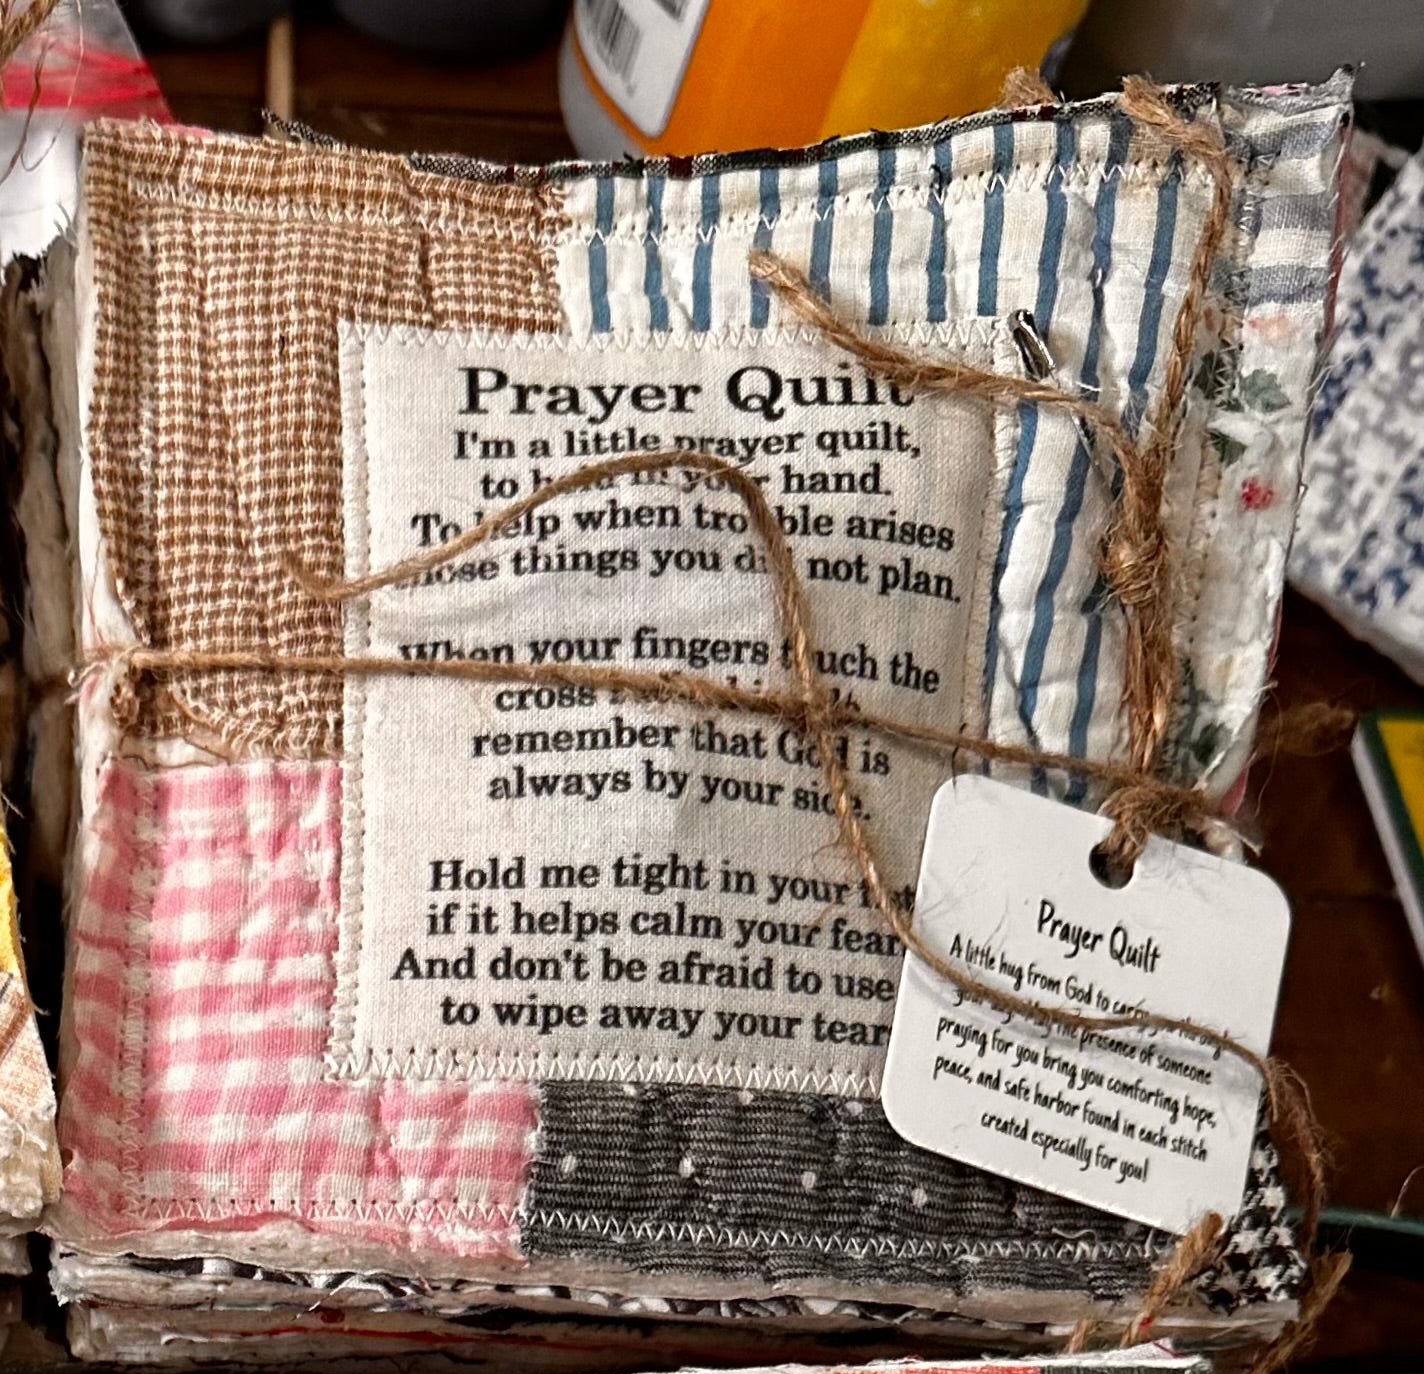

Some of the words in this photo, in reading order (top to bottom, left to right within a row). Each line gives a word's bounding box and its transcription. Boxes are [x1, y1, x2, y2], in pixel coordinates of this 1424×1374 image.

[458, 366, 704, 425] Prayer
[453, 429, 516, 460] I'm
[528, 438, 552, 459] a
[563, 426, 661, 457] little
[815, 420, 921, 463] quilt,
[1037, 898, 1105, 959] Prayer
[1109, 925, 1161, 973] Quilt
[390, 945, 477, 981] And
[488, 945, 591, 982] don't
[599, 946, 648, 983] be
[657, 949, 776, 992] afraid
[783, 962, 824, 996] to
[831, 973, 896, 1008] use
[439, 995, 481, 1027] to
[491, 992, 588, 1036] wipe
[598, 1003, 706, 1040] away
[711, 1010, 804, 1043] your
[936, 1016, 995, 1059] praying
[991, 1028, 1014, 1055] for
[1011, 1045, 1040, 1069] you
[1042, 1045, 1078, 1090] bring
[1076, 1068, 1105, 1091] you
[1106, 1077, 1180, 1125] comforting
[1182, 1095, 1217, 1131] hope,
[932, 1055, 973, 1084] peace,
[976, 1068, 1002, 1092] and
[1004, 1077, 1031, 1102] safe
[1033, 1081, 1081, 1118] harbor
[1082, 1099, 1121, 1133] found
[1122, 1119, 1137, 1139] in
[1138, 1125, 1169, 1149] each
[1170, 1135, 1208, 1162] stitch
[980, 1112, 1030, 1142] created
[1031, 1130, 1093, 1172] especially
[1095, 1144, 1118, 1170] for
[1115, 1157, 1150, 1185] you!
